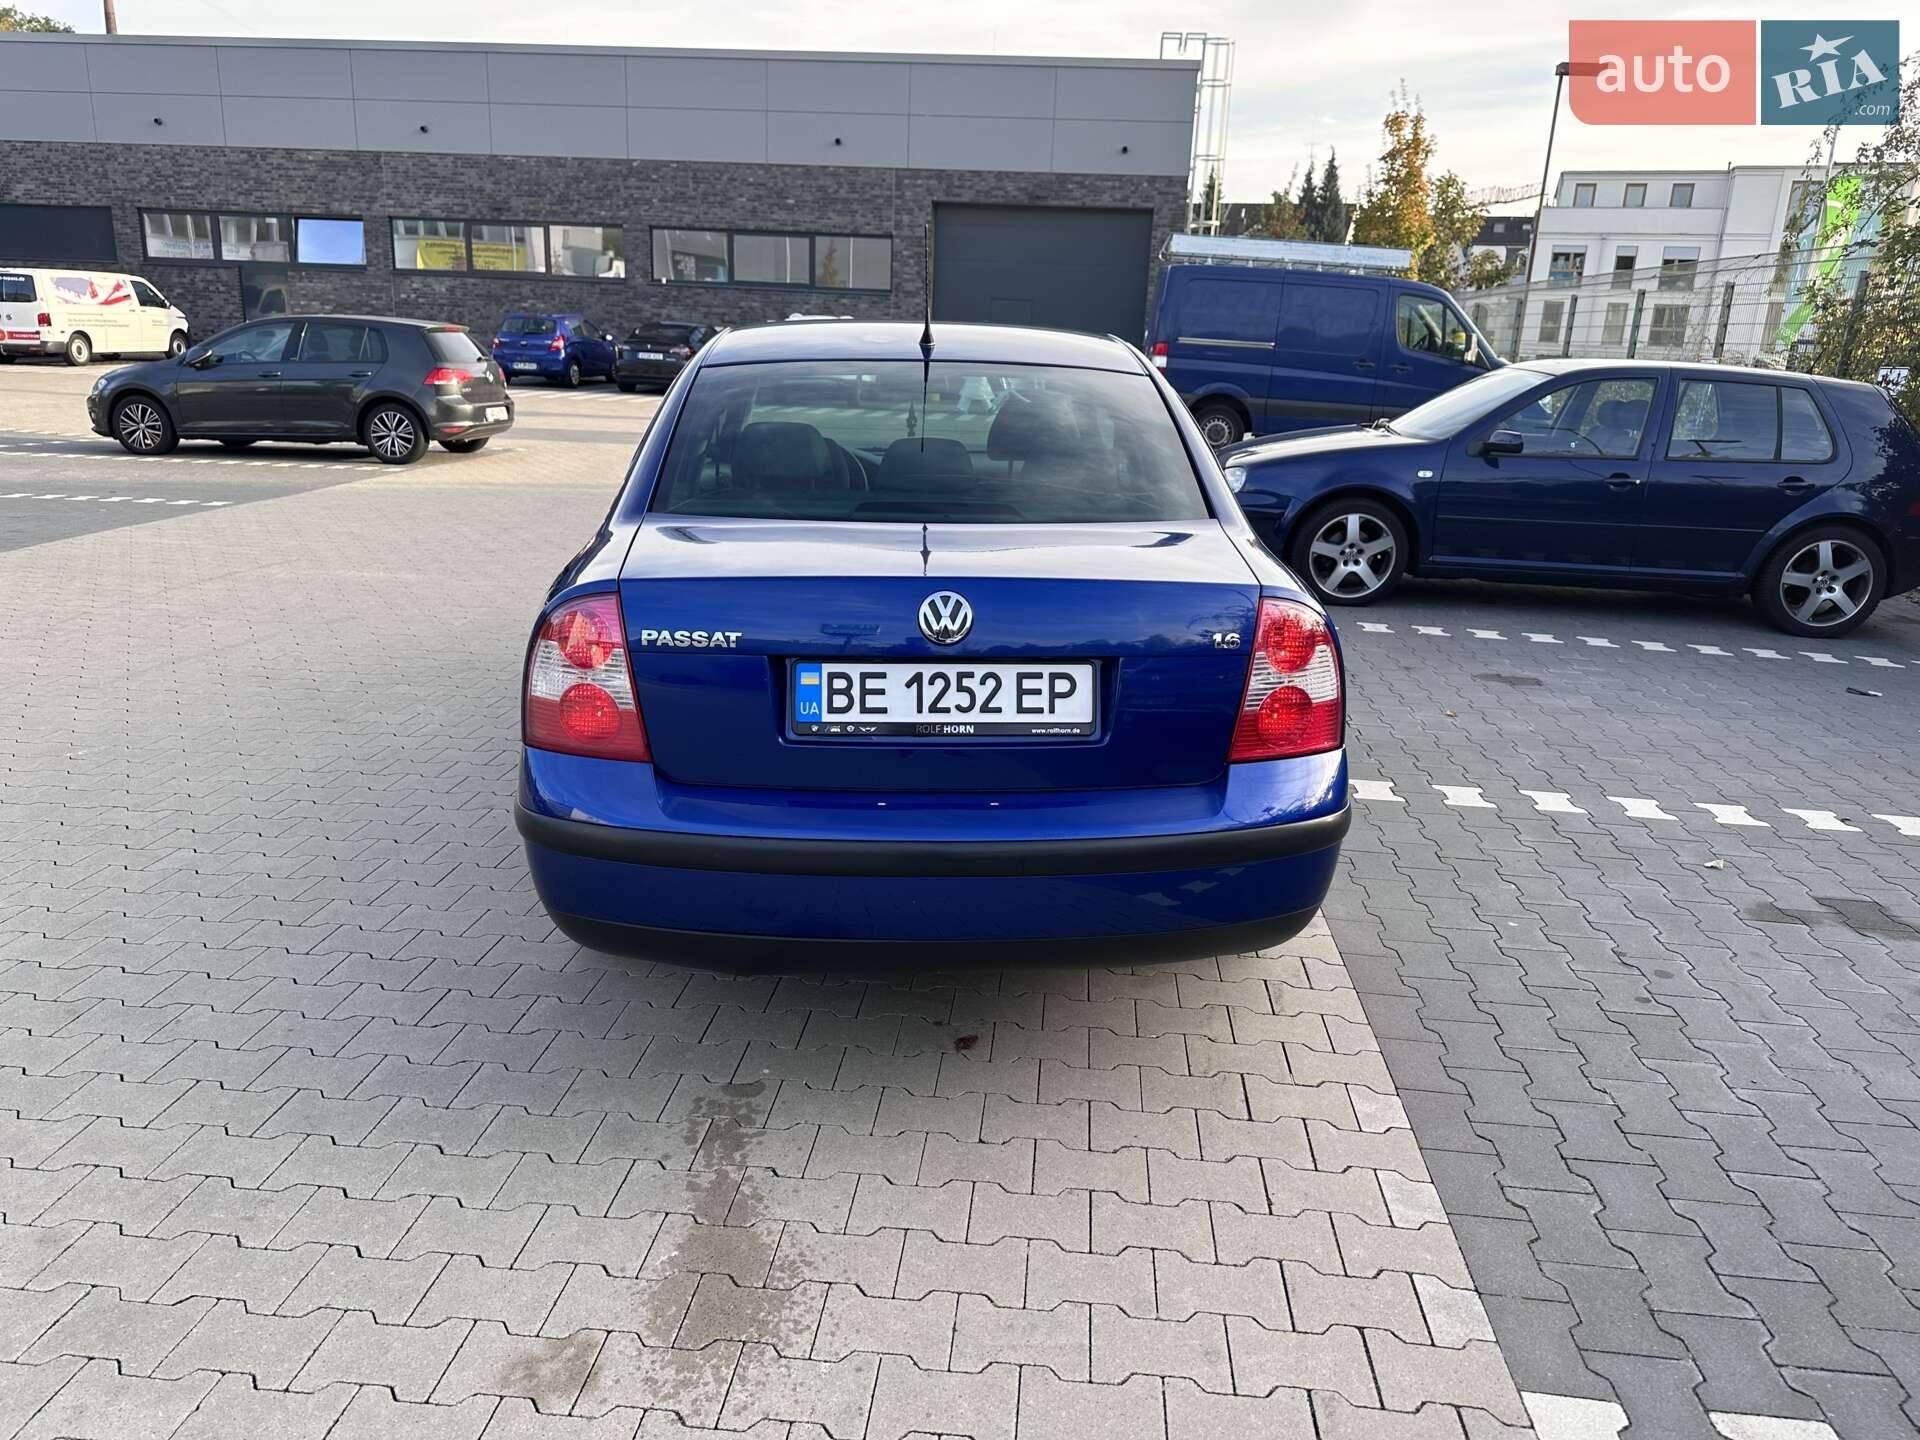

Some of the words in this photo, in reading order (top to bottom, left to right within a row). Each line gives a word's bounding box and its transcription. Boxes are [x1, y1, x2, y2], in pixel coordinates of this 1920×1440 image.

[919, 590, 972, 644] VW
[641, 629, 742, 648] PASSAT
[826, 671, 888, 715] BE
[904, 671, 1003, 714] 1252
[1016, 671, 1077, 714] EP
[799, 701, 819, 715] UA
[915, 724, 941, 734] ROLF
[943, 724, 975, 734] HORN
